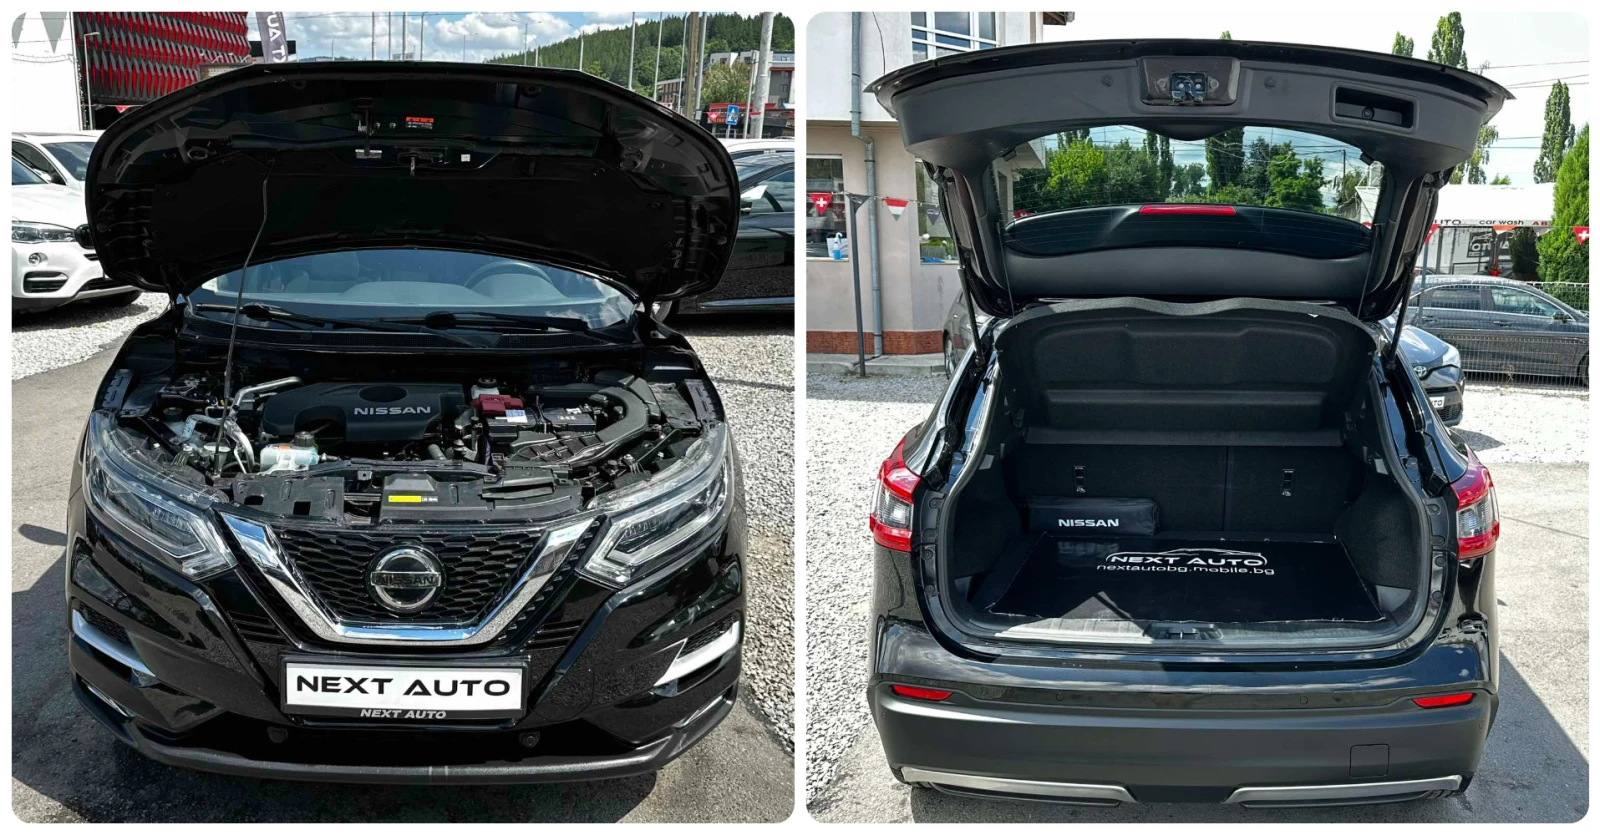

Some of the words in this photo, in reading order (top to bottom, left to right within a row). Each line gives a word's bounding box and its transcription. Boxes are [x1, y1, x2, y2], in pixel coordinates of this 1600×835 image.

[354, 406, 431, 415] NISSAN
[1058, 518, 1119, 527] NISSAN
[1111, 556, 1181, 565] NEXT
[1186, 557, 1265, 566] AUTO
[1096, 564, 1275, 576] nextautobg.mobile.bg
[379, 575, 434, 585] NISSAN
[297, 675, 393, 695] NEXT
[403, 678, 510, 696] AUTO
[360, 709, 402, 718] NEXT
[404, 710, 446, 719] AUTO
